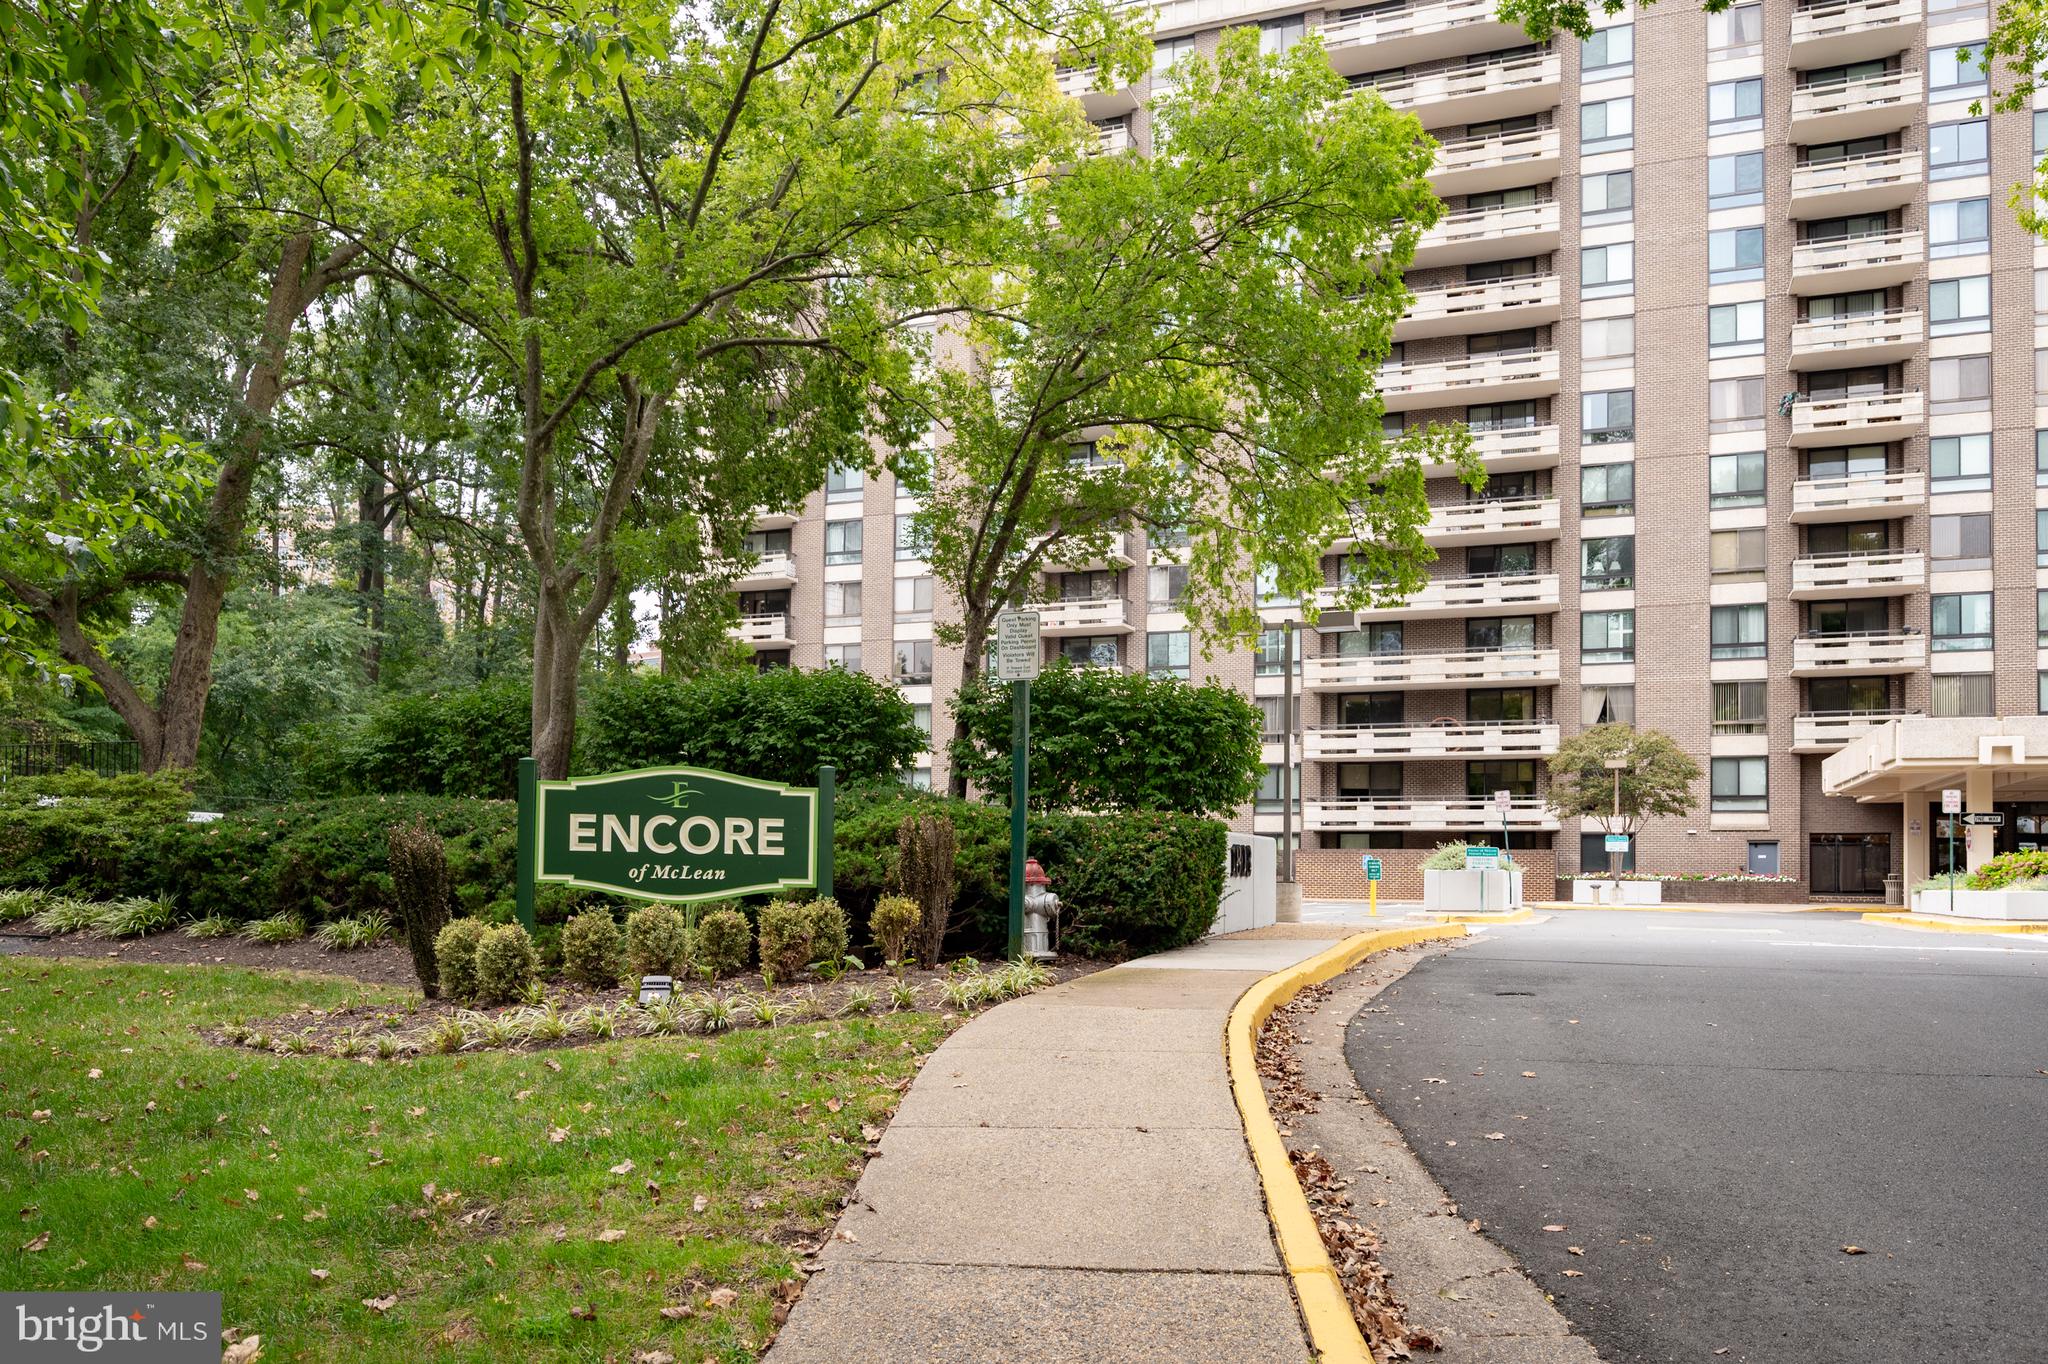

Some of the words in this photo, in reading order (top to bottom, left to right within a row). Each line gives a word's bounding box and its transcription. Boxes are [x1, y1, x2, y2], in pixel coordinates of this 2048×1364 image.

[568, 813, 785, 856] ENCORE
[628, 863, 650, 883] of
[650, 864, 726, 881] McLean
